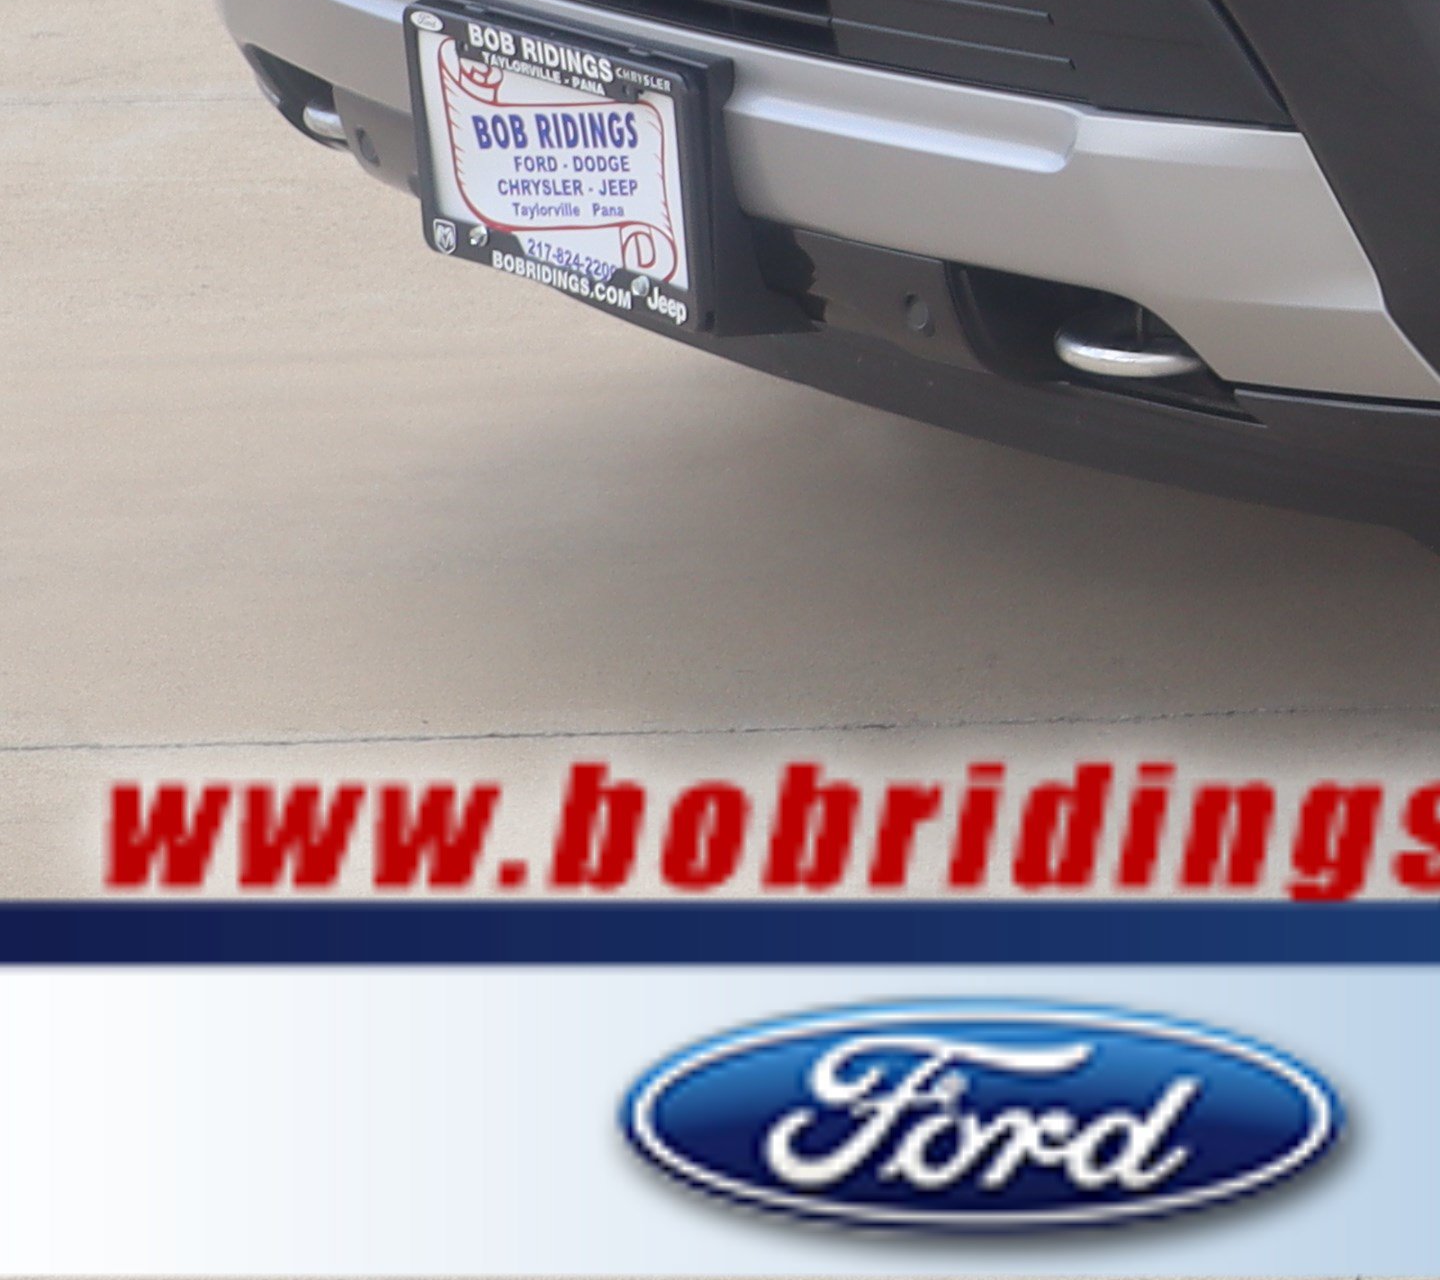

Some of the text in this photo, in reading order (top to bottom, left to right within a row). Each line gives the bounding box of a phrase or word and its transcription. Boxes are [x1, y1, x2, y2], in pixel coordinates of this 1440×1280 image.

[467, 22, 614, 83] BOB RIDINGS
[481, 50, 562, 85] TAYLORVILLE
[571, 75, 606, 96] PANA
[615, 67, 671, 92] CHRYSLER
[472, 111, 639, 150] BOB RIDINGS
[513, 155, 558, 172] FORD
[573, 155, 630, 172] DODGE
[497, 179, 584, 196] CHRYSLER
[598, 179, 638, 196] JEEP
[512, 202, 625, 220] Taylorville Pana
[492, 249, 632, 310] BOBRIDINGS.COM
[646, 286, 687, 325] Jeep
